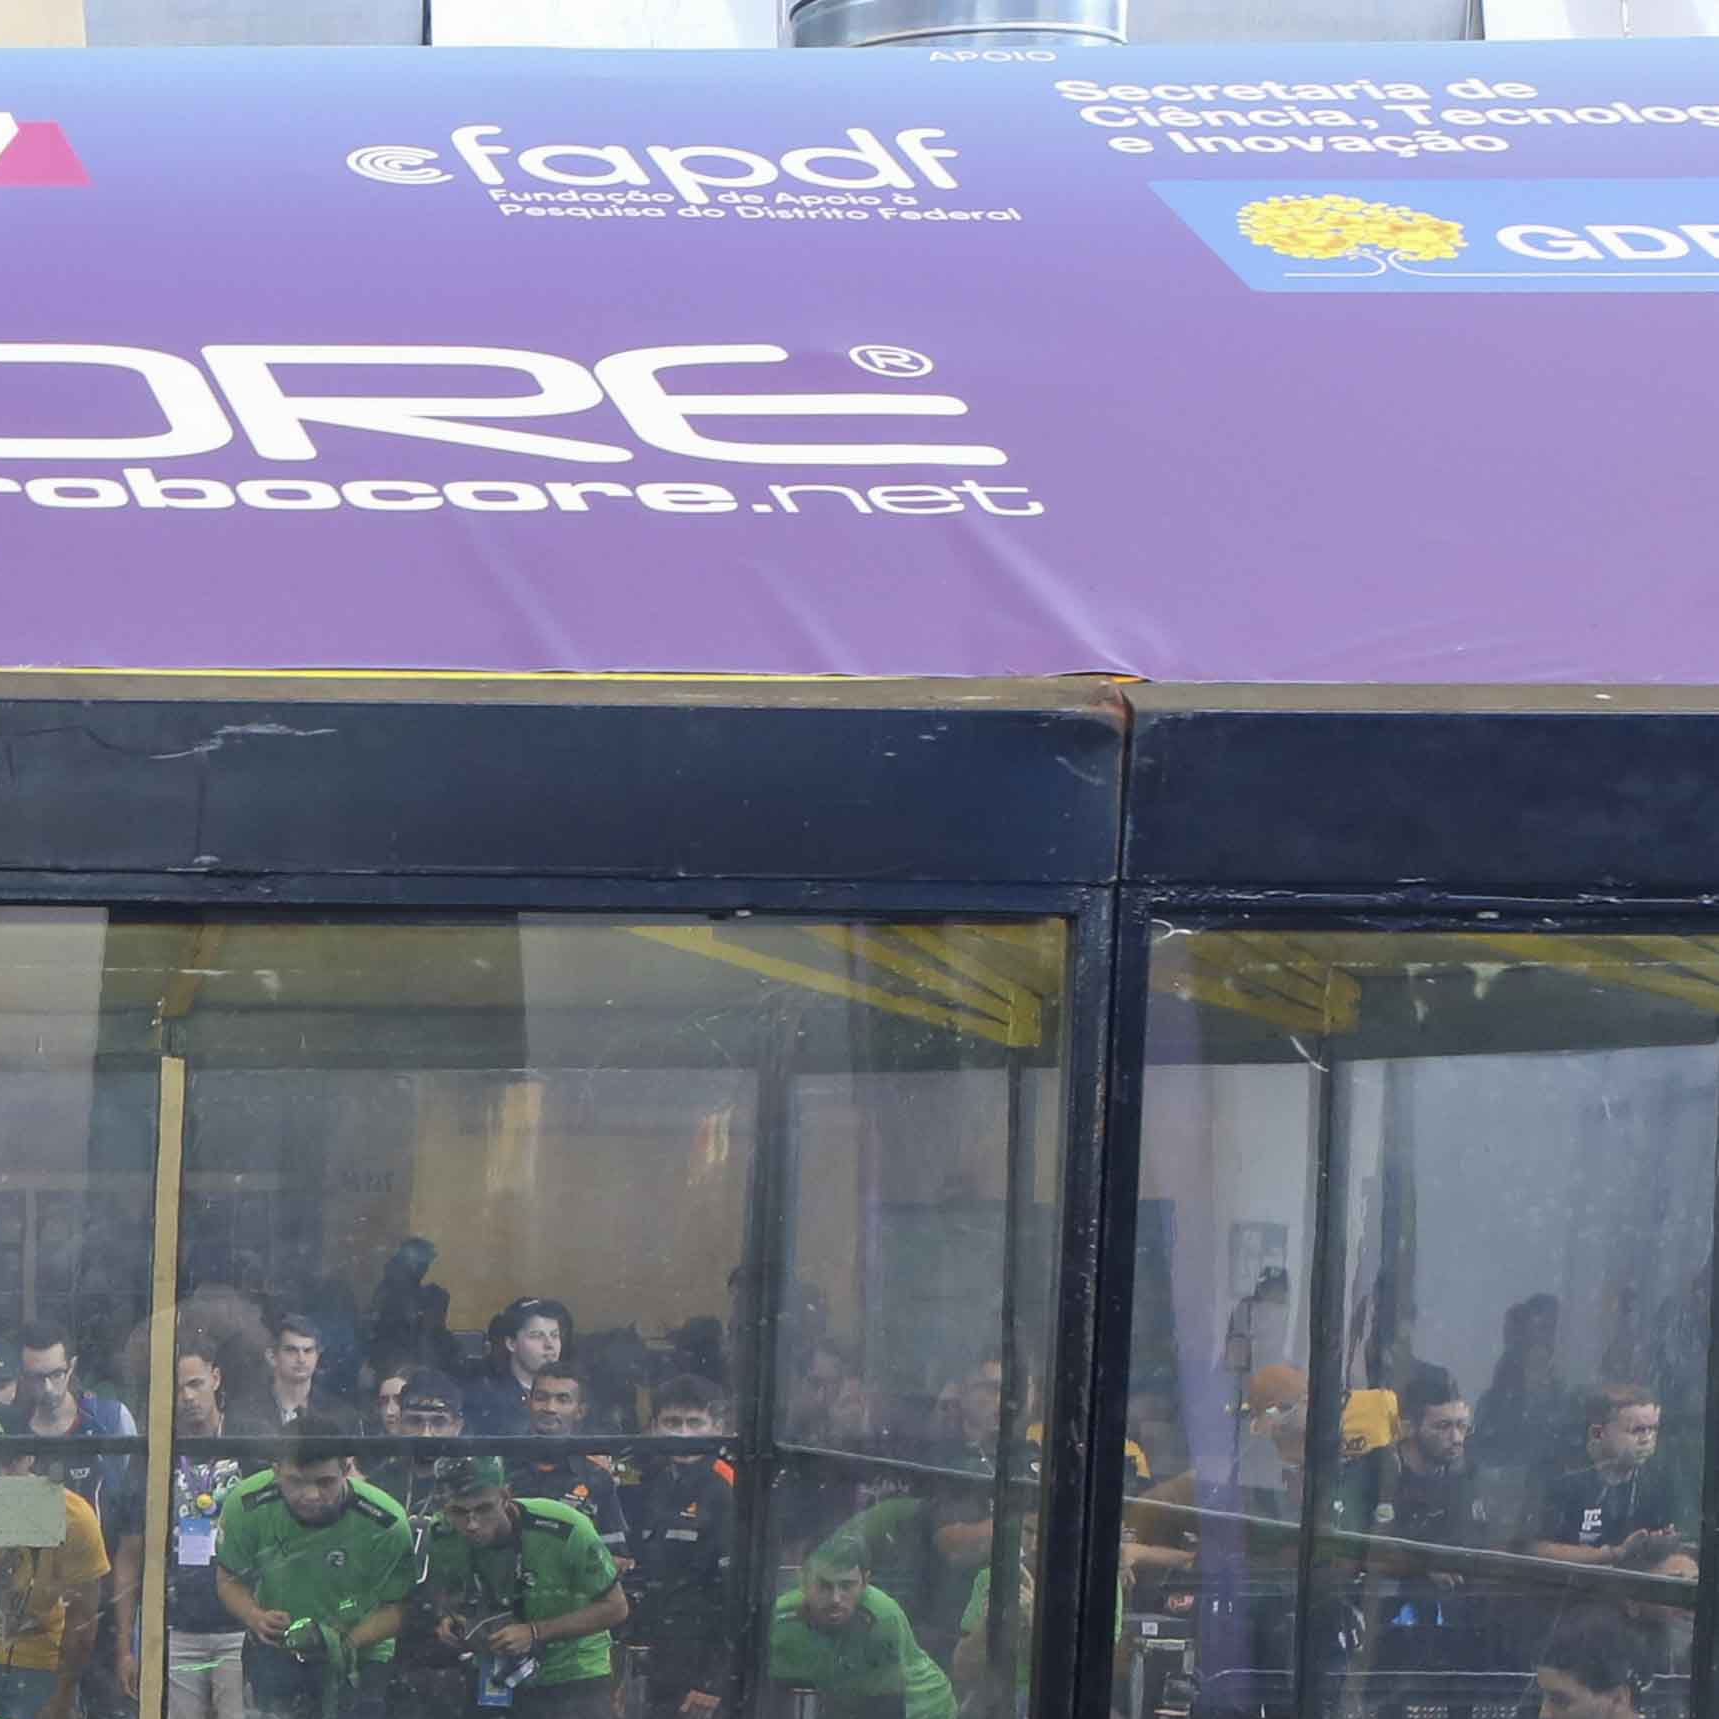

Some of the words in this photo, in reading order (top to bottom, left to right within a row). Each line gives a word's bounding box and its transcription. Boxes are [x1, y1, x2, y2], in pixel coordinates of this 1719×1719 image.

[929, 50, 1058, 63] APOIO
[1054, 79, 1430, 102] Secretaria
[1446, 78, 1539, 100] de
[1079, 104, 1380, 130] Ciência,
[1108, 136, 1155, 154] e
[1167, 129, 1510, 159] Inovação
[450, 124, 959, 205] fapdf
[488, 188, 676, 206] Fundação
[717, 190, 765, 205] de
[774, 191, 882, 208] Apoio
[498, 203, 666, 221] Pesquisa
[676, 205, 727, 220] do
[736, 206, 871, 222] Distrito
[879, 207, 1024, 223] Federal
